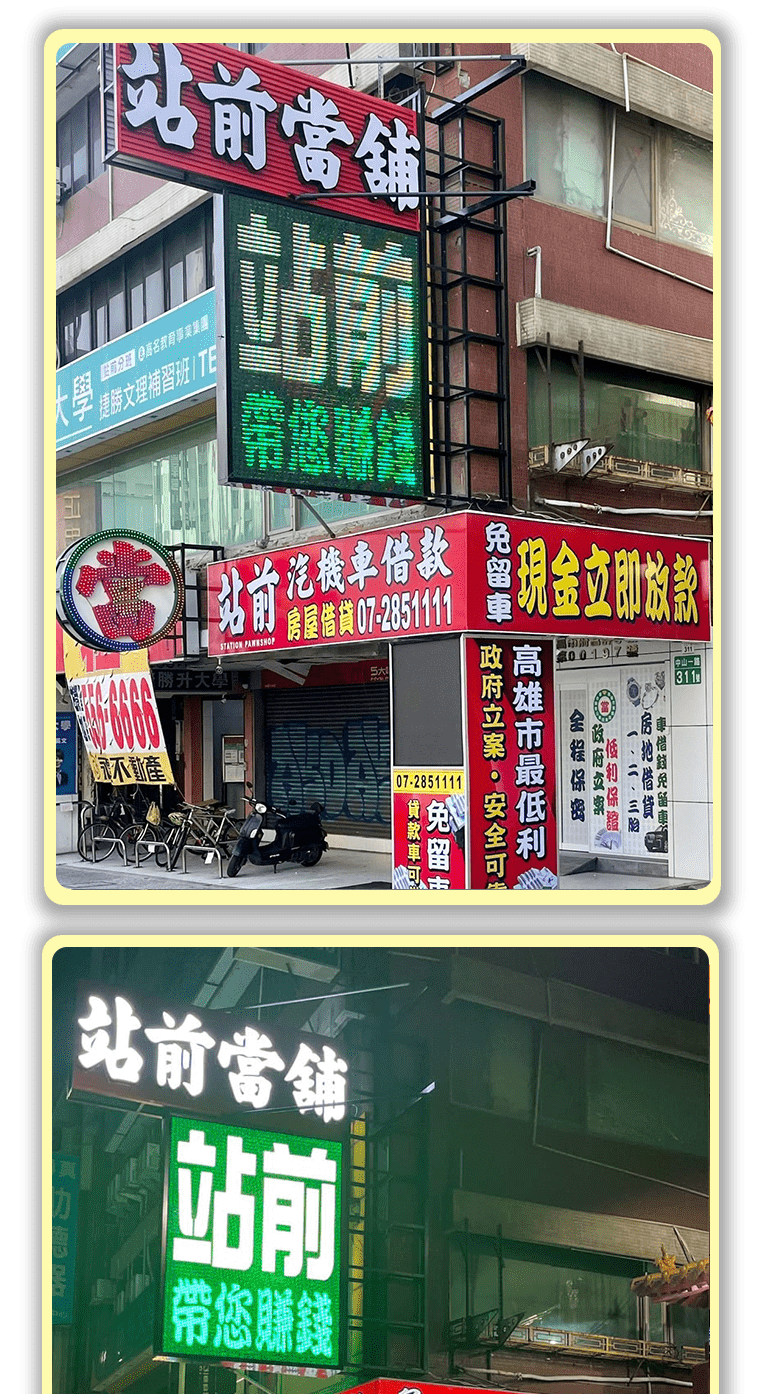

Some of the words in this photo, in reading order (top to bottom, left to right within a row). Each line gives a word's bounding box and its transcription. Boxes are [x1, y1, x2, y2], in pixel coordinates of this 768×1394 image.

[117, 43, 421, 212] 站前當舖
[237, 213, 414, 399] 站前
[217, 557, 281, 636] 站前
[287, 525, 453, 600] 汽機車借款
[485, 521, 513, 623] 免留車
[516, 537, 699, 625] 現金立即放款
[220, 640, 243, 651] STATION
[244, 637, 276, 649] PAWNSHOP
[287, 600, 355, 642] 房屋借貸
[357, 585, 453, 635] 07-2851111
[396, 774, 462, 790] 07-2851111
[512, 644, 546, 861] 高雄市最低利
[570, 708, 585, 823] 全程保密
[592, 724, 605, 816] 政府立案
[605, 738, 620, 832] 低利保證
[641, 711, 655, 820] 房地借貸
[78, 996, 348, 1123] 站前當舖
[172, 1129, 337, 1281] 站前
[172, 1277, 332, 1358] 帶您賺錢
